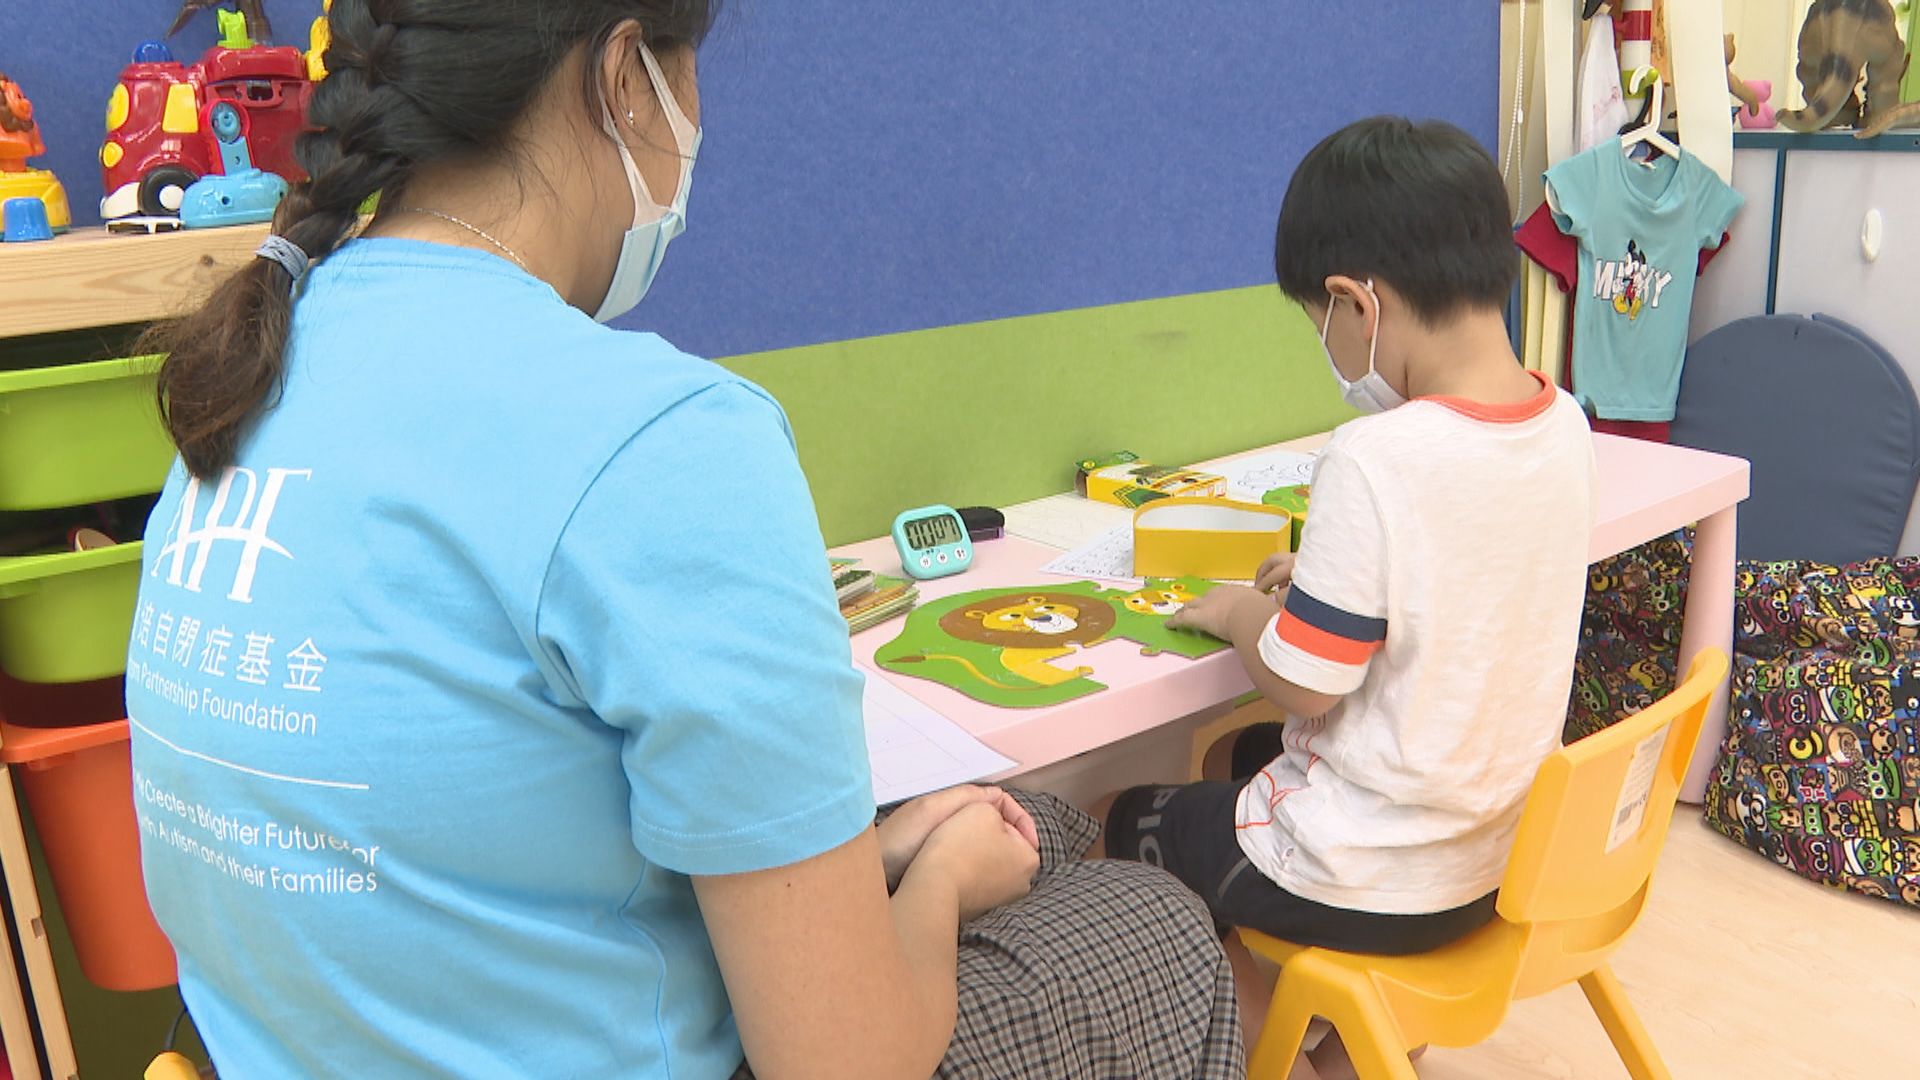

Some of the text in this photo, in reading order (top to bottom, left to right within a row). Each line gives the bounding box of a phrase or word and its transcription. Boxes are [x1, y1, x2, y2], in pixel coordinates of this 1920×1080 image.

[140, 662, 198, 713] Partnership
[202, 688, 316, 736] Foundation
[145, 779, 187, 817] Create
[197, 803, 260, 846] Brighter
[266, 822, 344, 850] Future
[346, 842, 379, 867] or
[203, 846, 226, 873] and
[227, 855, 264, 888] their
[271, 867, 377, 893] Families
